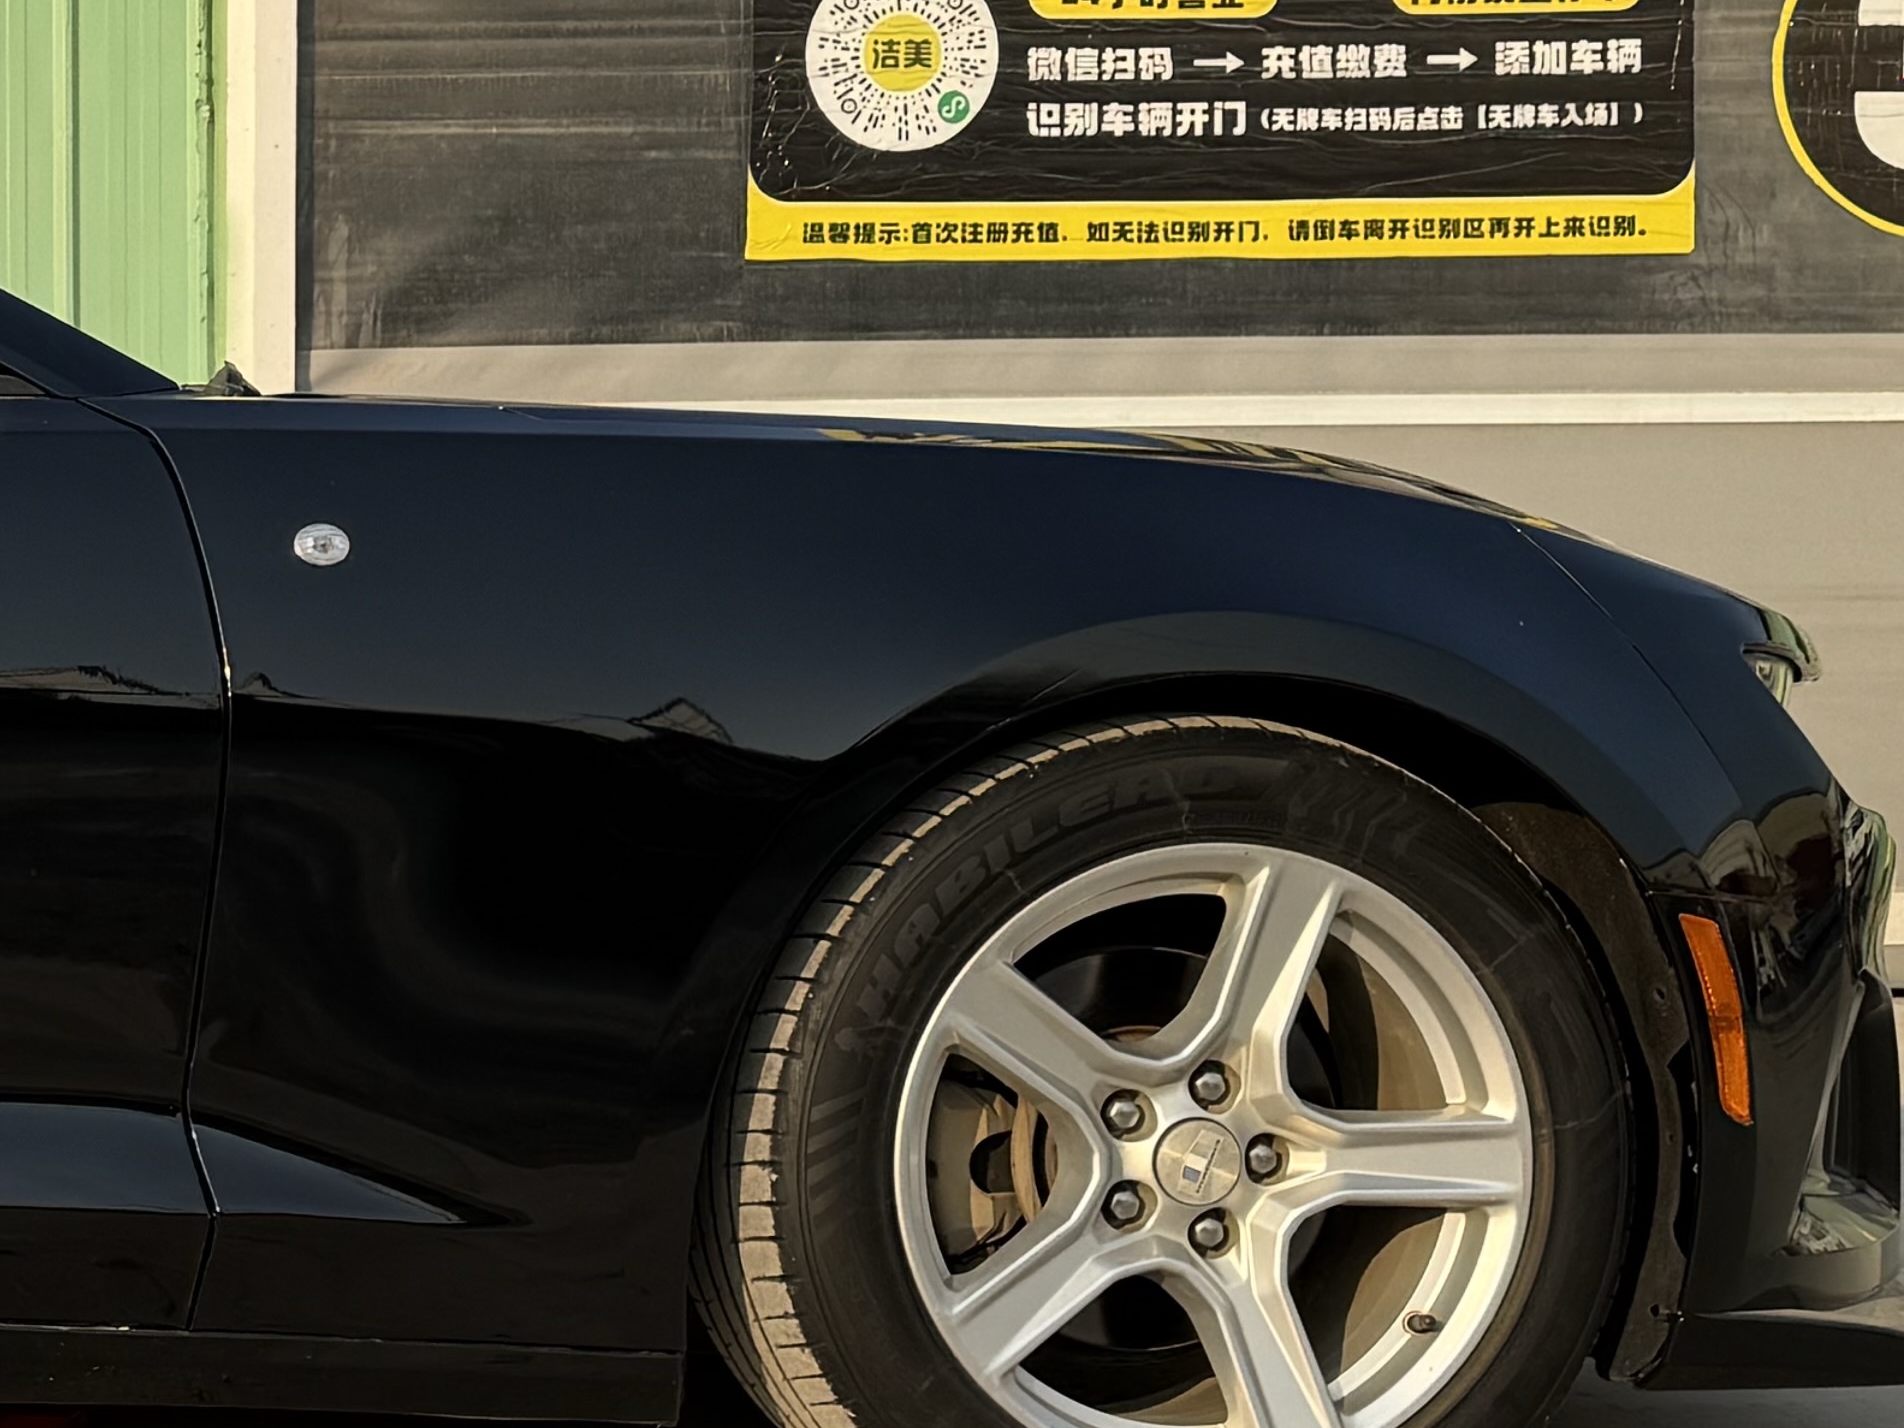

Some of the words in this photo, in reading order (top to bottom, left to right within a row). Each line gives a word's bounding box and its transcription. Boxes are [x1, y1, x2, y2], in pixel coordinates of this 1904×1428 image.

[872, 39, 932, 69] 洁美
[1027, 47, 1174, 83] 微信扫码
[1261, 45, 1408, 80] 充值缴费
[1495, 39, 1643, 77] 添加车辆
